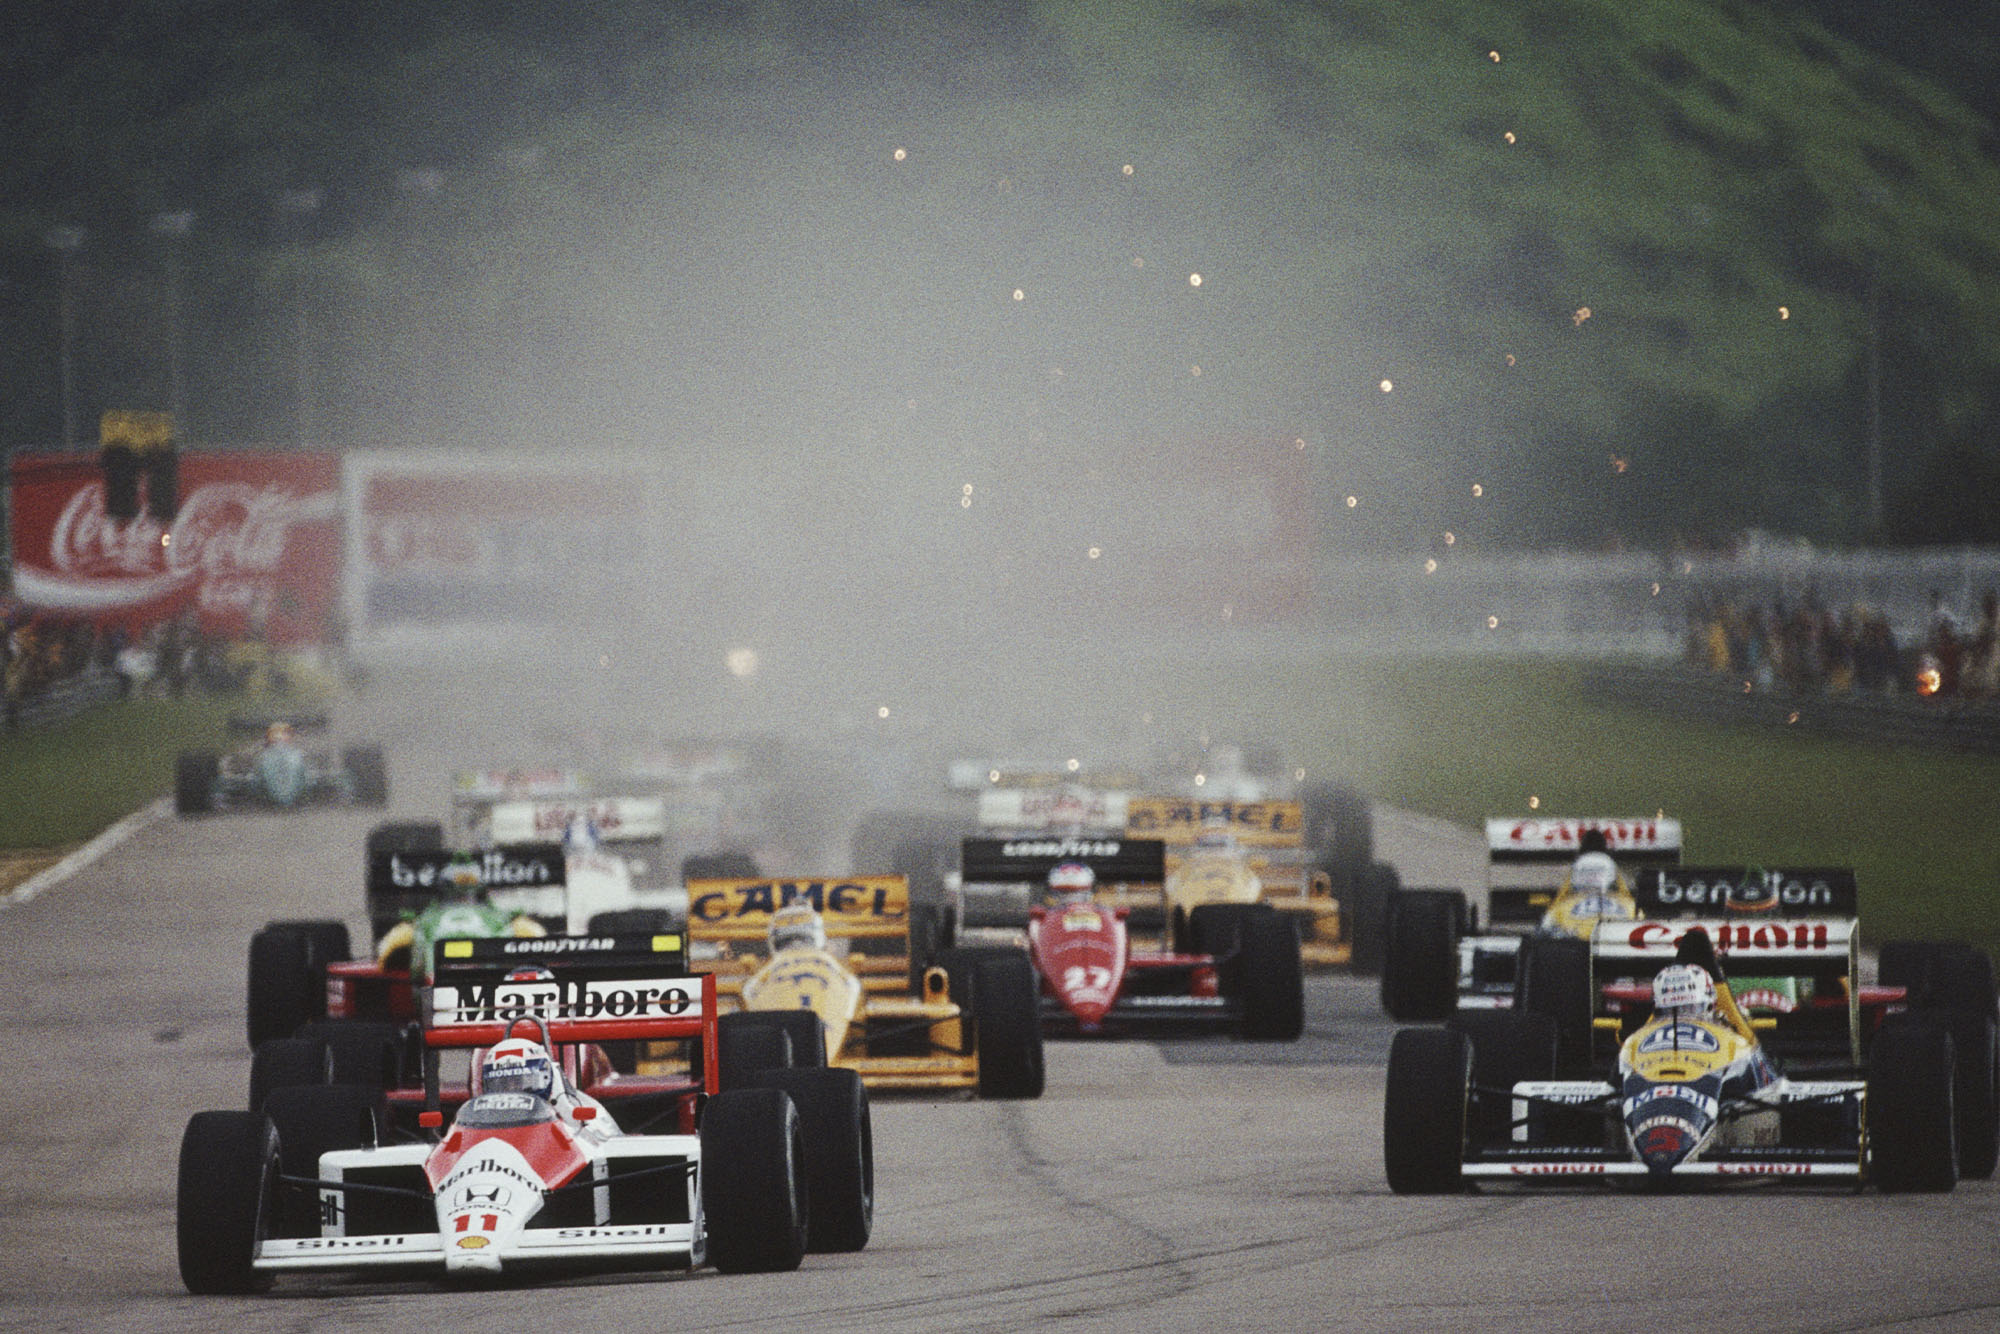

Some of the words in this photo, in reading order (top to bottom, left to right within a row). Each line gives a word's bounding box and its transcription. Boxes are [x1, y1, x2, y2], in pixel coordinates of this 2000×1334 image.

[691, 882, 905, 922] CAMEL
[504, 938, 615, 954] GOODYEAR
[1628, 923, 1828, 949] Cnon
[1063, 965, 1112, 991] 27
[454, 981, 690, 1022] Marlboro
[488, 1067, 532, 1079] HONDA
[1644, 1126, 1684, 1156] 5
[438, 1159, 539, 1194] Marlboro
[452, 1213, 499, 1233] 11
[558, 1227, 666, 1238] Shell
[296, 1237, 404, 1249] Shell
